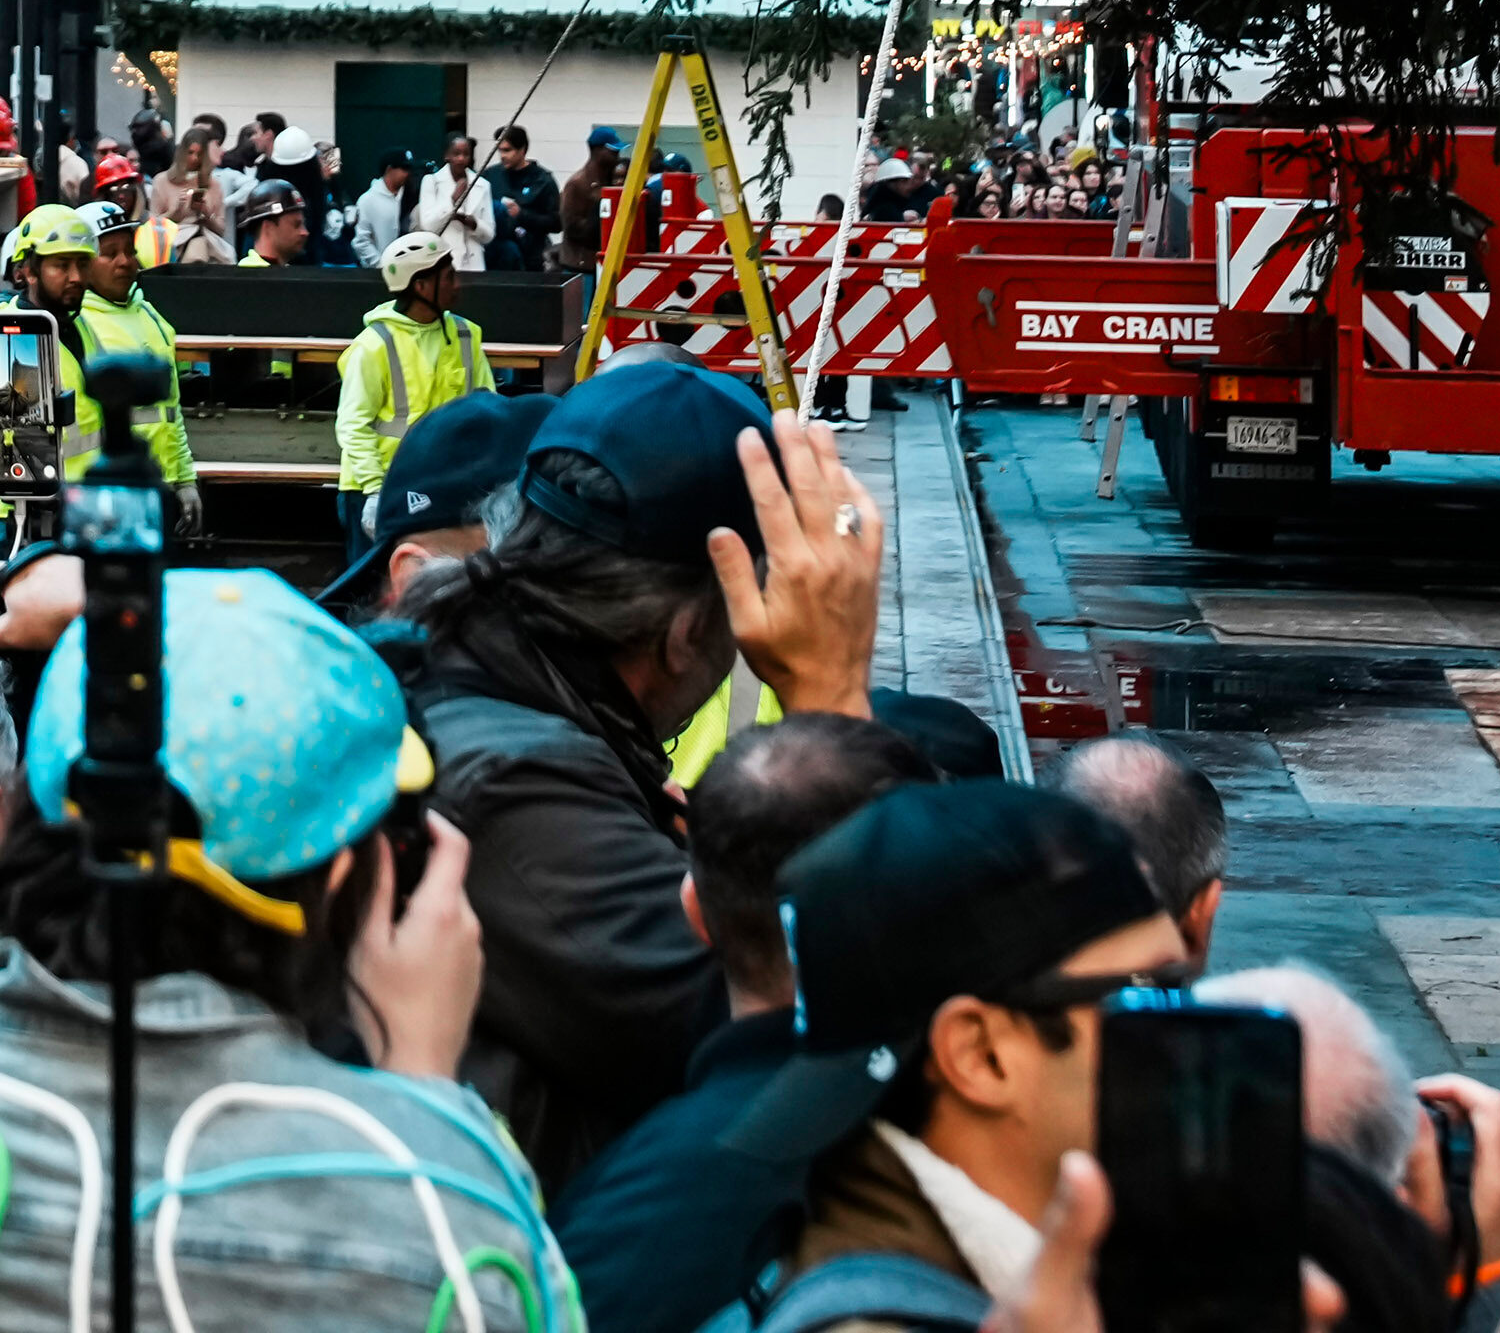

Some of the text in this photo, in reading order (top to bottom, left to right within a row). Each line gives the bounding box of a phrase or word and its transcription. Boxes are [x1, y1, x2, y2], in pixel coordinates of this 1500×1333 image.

[690, 83, 719, 142] DELRO
[1021, 313, 1214, 341] BAY CRANE
